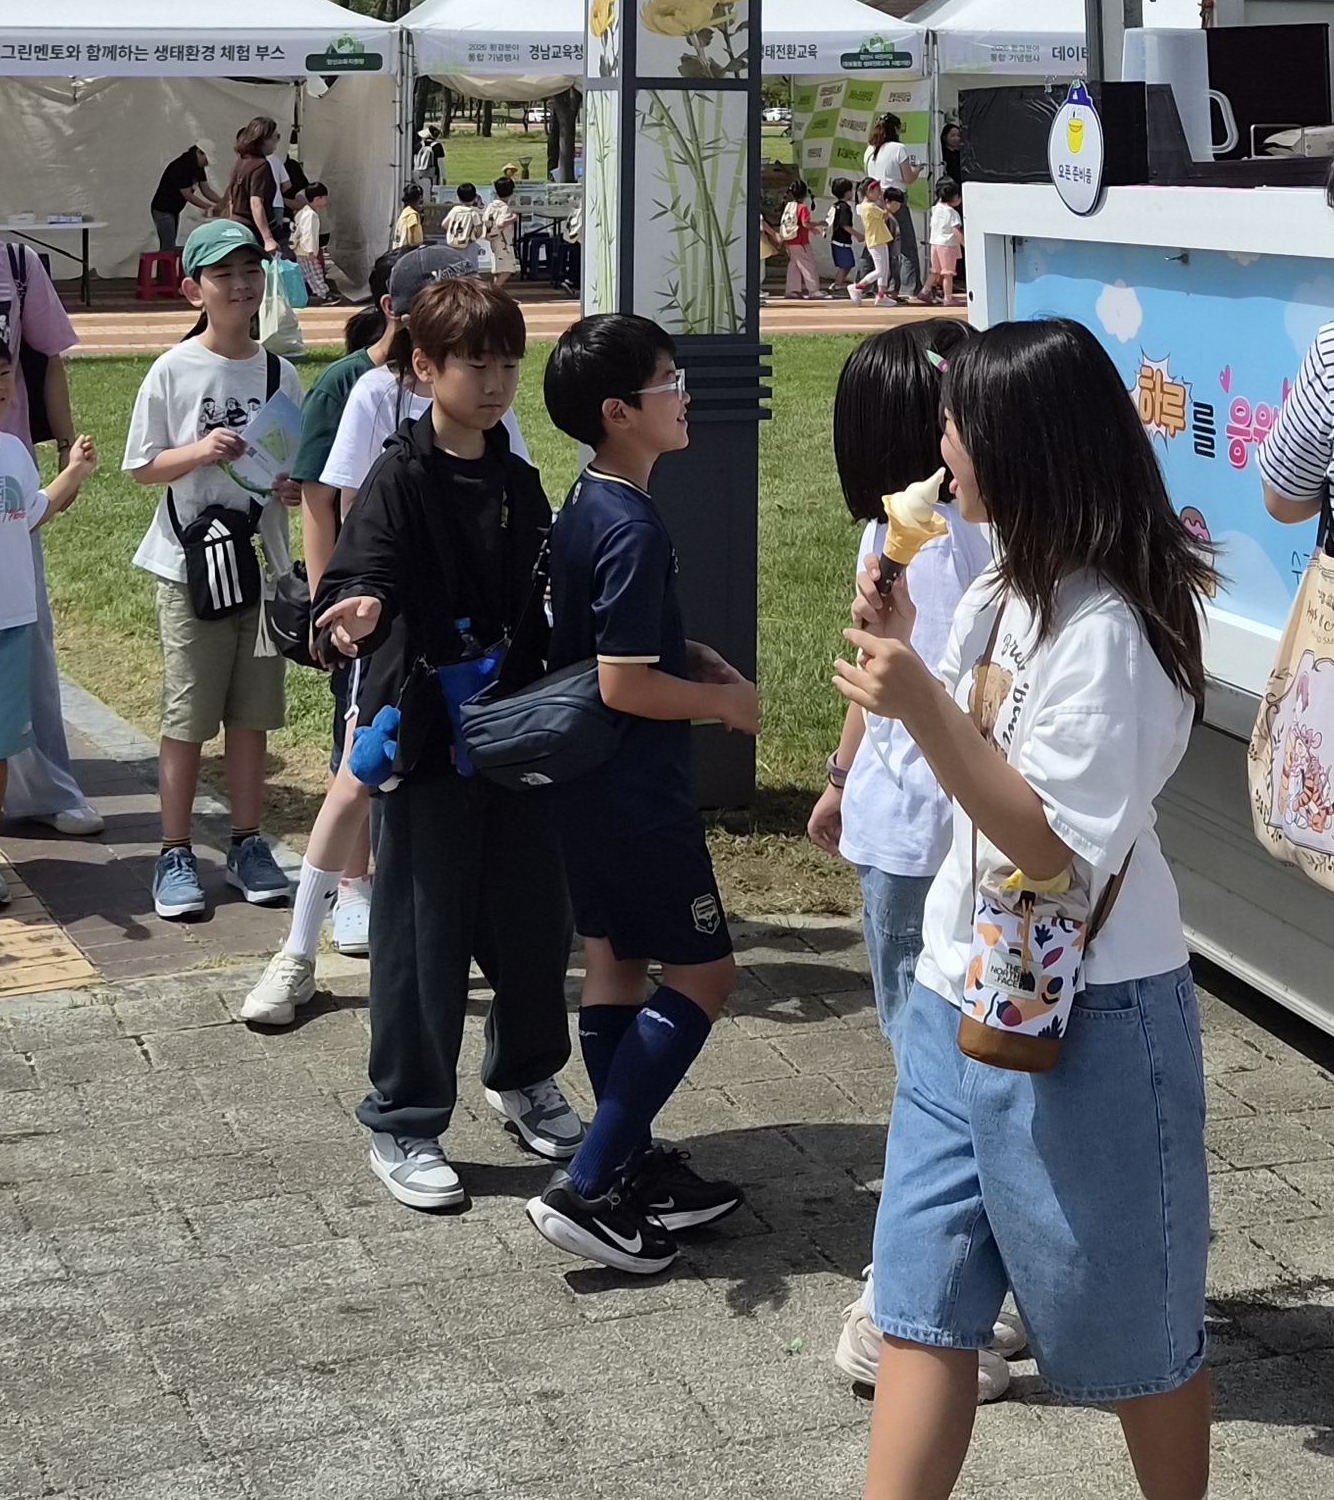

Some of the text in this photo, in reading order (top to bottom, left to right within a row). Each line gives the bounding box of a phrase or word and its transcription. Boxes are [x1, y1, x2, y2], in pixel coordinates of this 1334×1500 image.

[0, 43, 82, 61] 그린멘토와
[86, 44, 149, 62] 함께하는
[154, 44, 216, 62] 생태환경
[220, 45, 251, 62] 체험
[255, 45, 286, 61] 부스
[468, 43, 520, 52] 2026 환경분야
[529, 44, 584, 61] 경남교육청
[468, 53, 520, 62] 통합 기념행사
[990, 53, 1040, 63] 통합 기념행사
[1058, 164, 1092, 185] 오픈준비중
[991, 965, 1021, 983] NORTH
[1005, 963, 1022, 972] THE
[997, 975, 1018, 988] FACE
